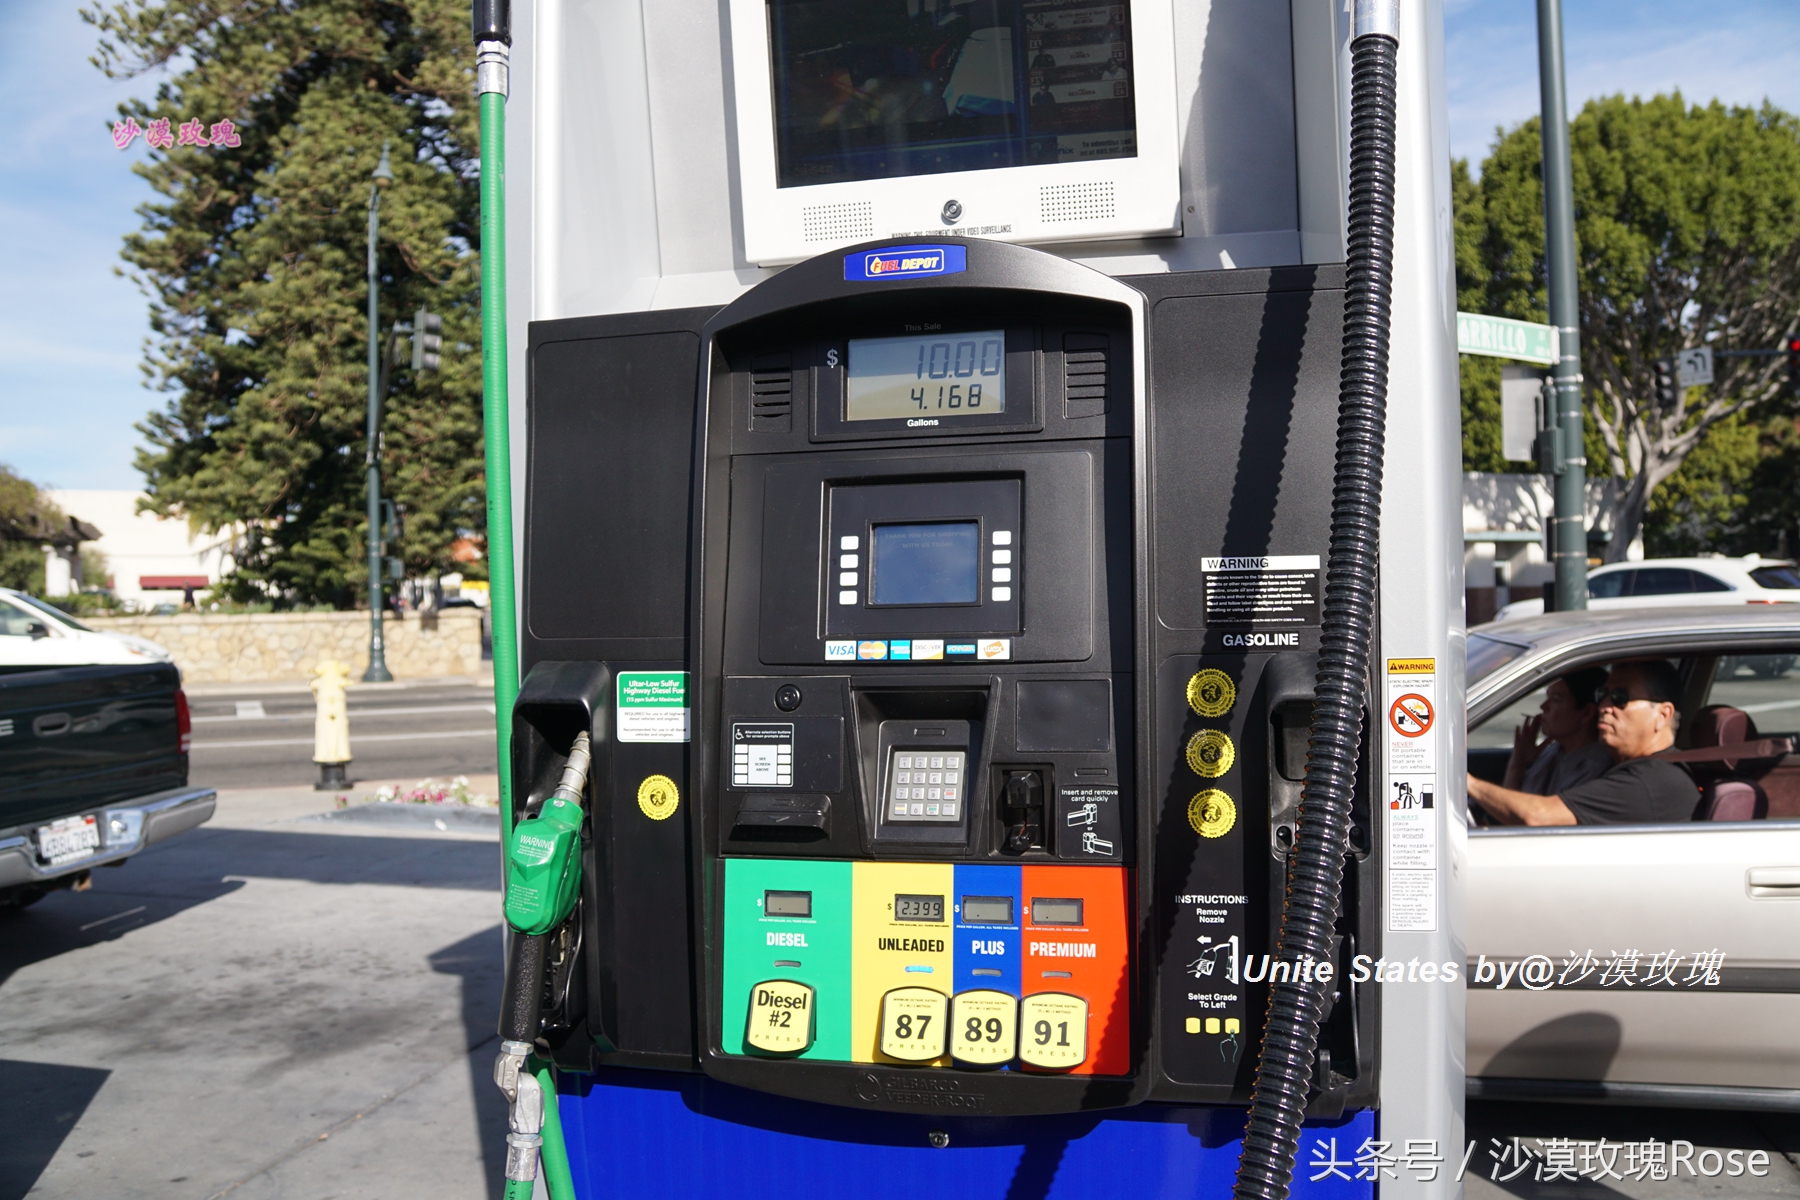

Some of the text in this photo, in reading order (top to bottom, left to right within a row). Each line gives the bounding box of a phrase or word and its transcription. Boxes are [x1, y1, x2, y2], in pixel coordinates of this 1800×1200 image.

[967, 226, 979, 236] VIDEO
[980, 224, 1012, 235] SURVEILLANCE
[873, 257, 939, 272] FUEL DEPOT
[904, 323, 941, 332] This Sale
[1459, 319, 1526, 354] ARRILLO
[827, 348, 839, 368] $
[916, 339, 1001, 380] 10.00
[910, 383, 982, 410] 4.168
[907, 419, 939, 427] Gallons
[1207, 558, 1269, 569] WARNING
[1223, 633, 1299, 646] GASOLINE
[828, 645, 855, 656] VISA
[1398, 663, 1434, 671] WARNING
[623, 687, 651, 695] Highway
[520, 835, 553, 850] WARNING
[757, 898, 762, 907] $
[1175, 895, 1249, 904] INSTRUCTIONS
[887, 901, 941, 916] $ 2.399
[954, 904, 960, 913] $
[1023, 906, 1029, 915] $
[1196, 908, 1228, 916] Remove
[1199, 916, 1225, 924] Nozzle
[766, 932, 808, 947] DIESEL
[878, 937, 945, 953] UNLEADED
[972, 940, 1005, 955] PLUS
[1030, 942, 1096, 958] PREMIUM
[757, 989, 807, 1010] Diesel
[1188, 993, 1238, 1001] Select Grade
[1199, 1001, 1226, 1009] To Left
[769, 1011, 792, 1028] #2
[895, 1014, 932, 1040] 87
[965, 1017, 1003, 1043] 89
[1034, 1020, 1070, 1047] 91
[885, 1076, 960, 1091] GILBARCO
[886, 1092, 985, 1109] VEEDER-ROOT
